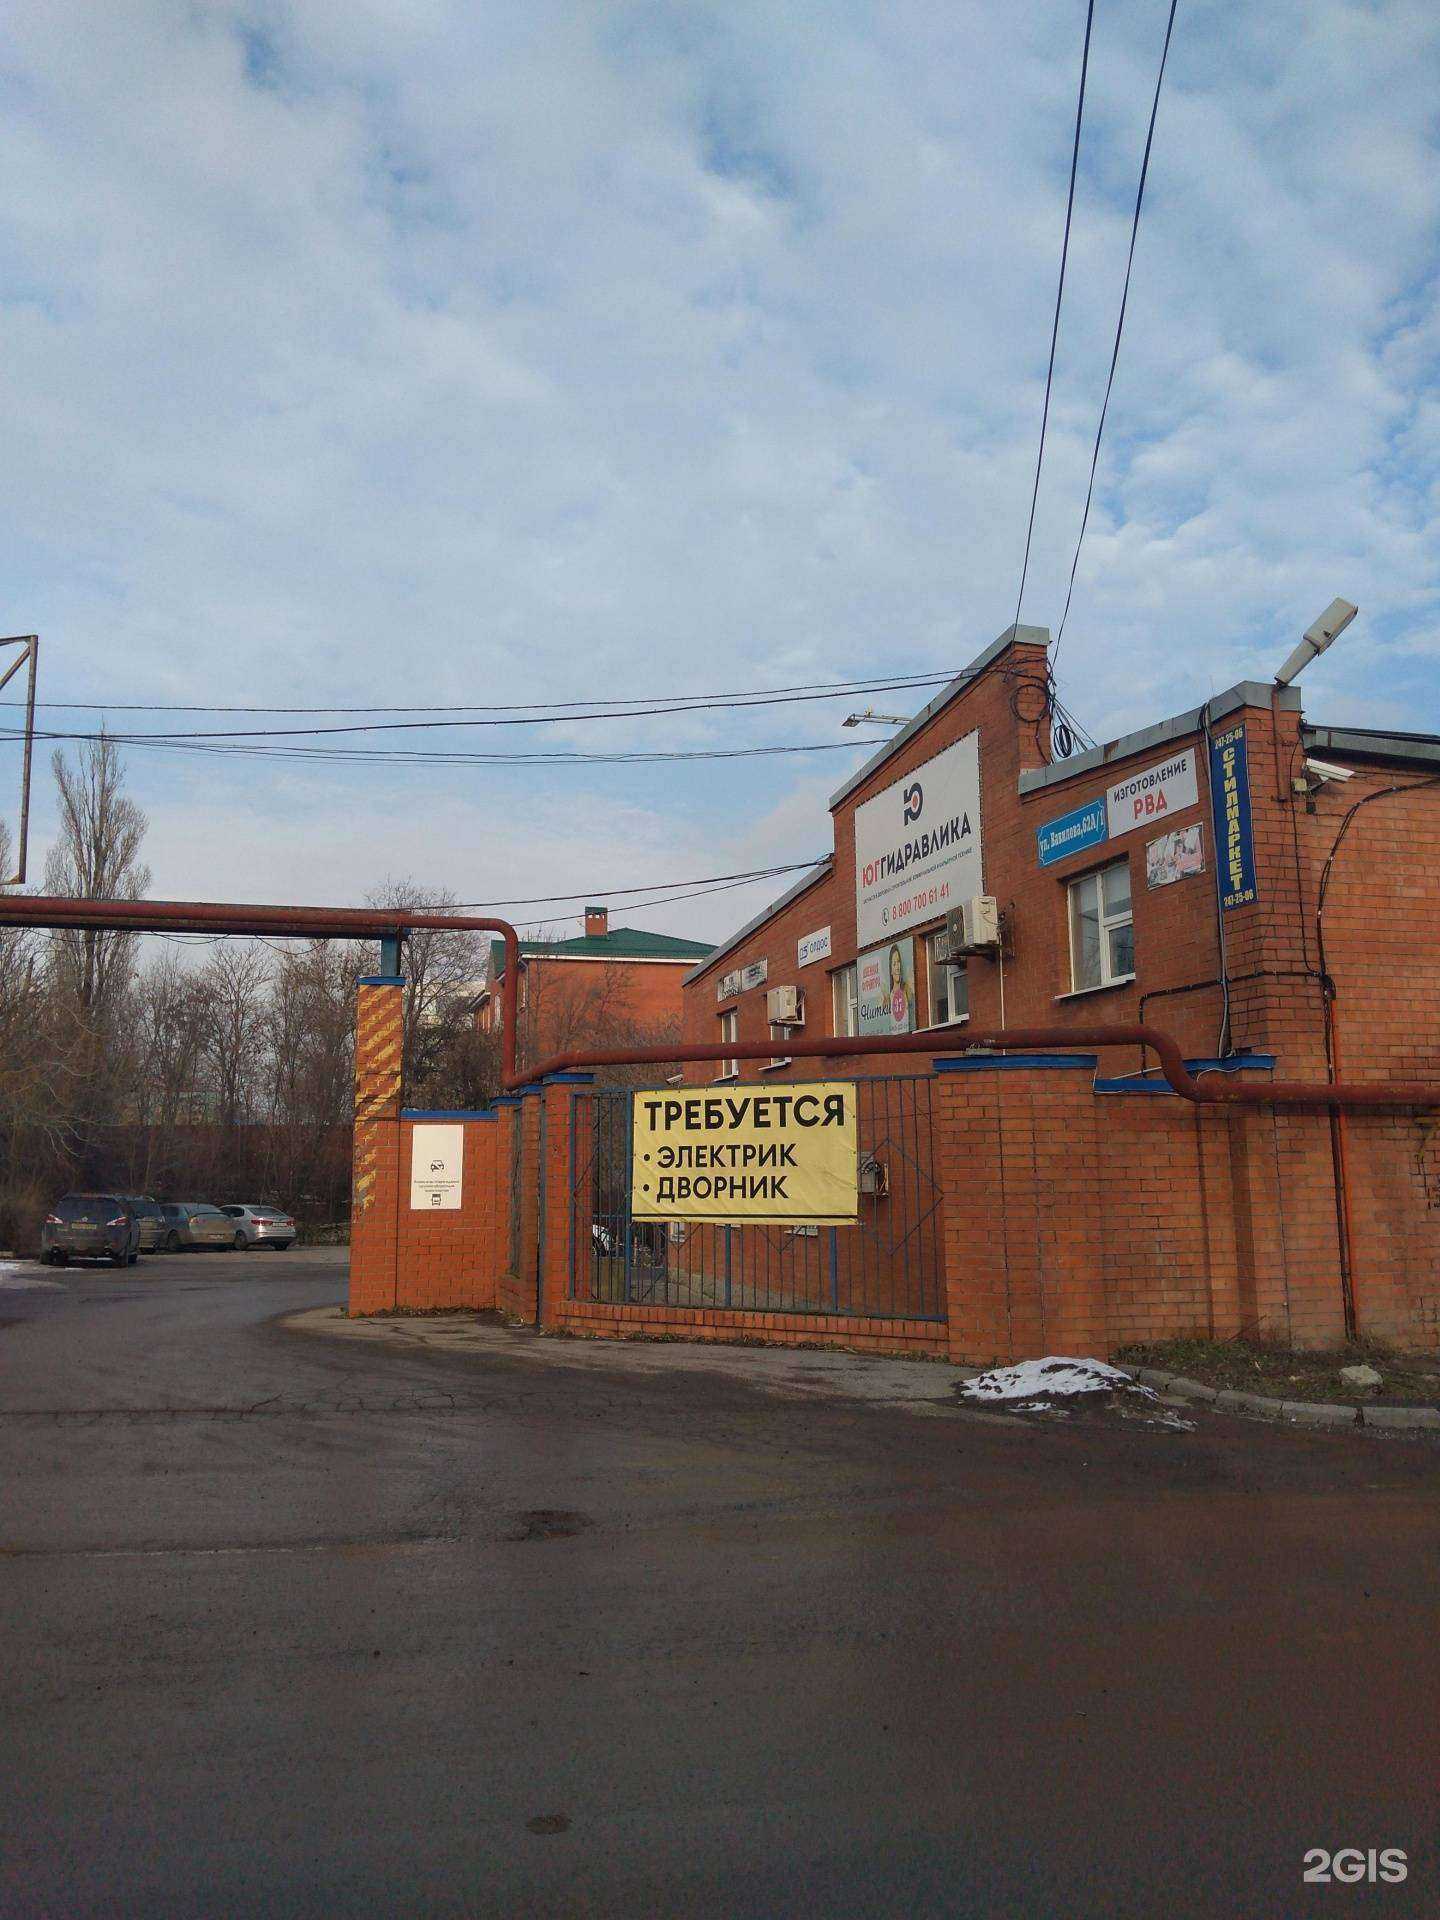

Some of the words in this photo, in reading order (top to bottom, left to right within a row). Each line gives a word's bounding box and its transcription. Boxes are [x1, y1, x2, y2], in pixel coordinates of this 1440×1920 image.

[1113, 758, 1188, 803] ИЗГОТОВЛЕНИЕ
[1133, 788, 1168, 821] РВД
[1222, 747, 1243, 891] СТИЛМАРКЕТ
[862, 811, 972, 889] ЮГГИДРАВЛИКА
[1040, 838, 1051, 858] ул.
[892, 905, 898, 921] 8
[898, 898, 912, 918] 800
[914, 892, 927, 912] 700
[929, 886, 938, 906] 61
[940, 881, 951, 899] 41
[644, 1094, 845, 1131] ТРЕБУЕТСЯ
[656, 1143, 798, 1169] ЭЛЕКТРИК
[656, 1175, 789, 1203] ДВОРНИК
